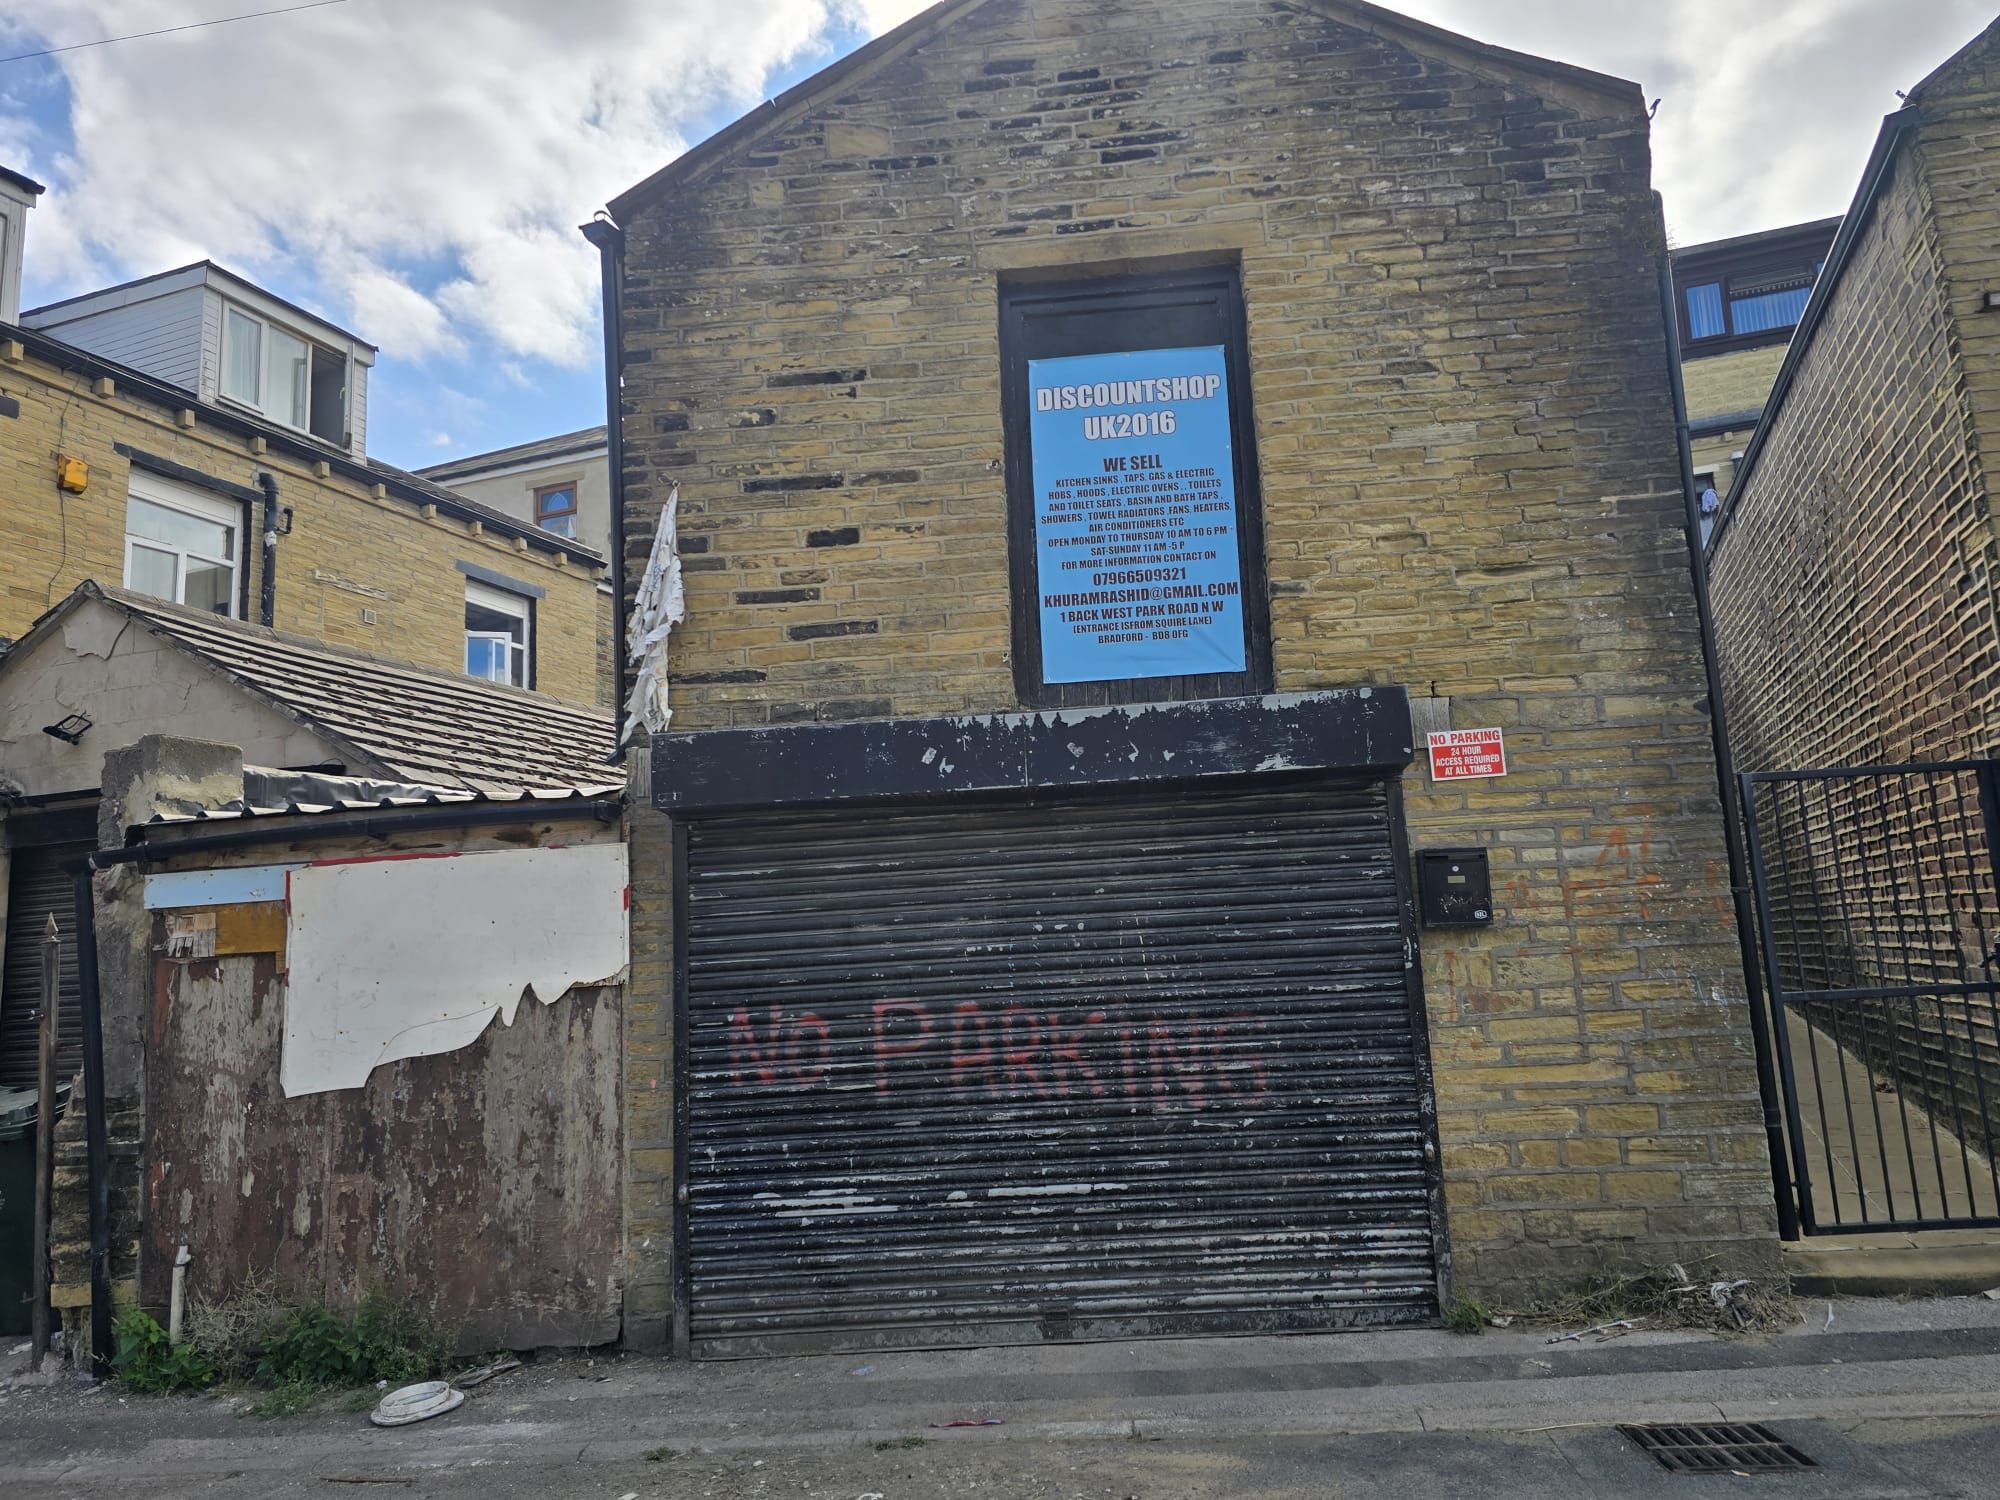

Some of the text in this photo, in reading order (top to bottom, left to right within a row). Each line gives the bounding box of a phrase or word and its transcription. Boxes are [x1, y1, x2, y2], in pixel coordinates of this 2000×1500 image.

[1036, 374, 1221, 411] DISCOUNTSHOP
[1084, 411, 1176, 440] UK2016
[1104, 455, 1162, 472] WE SELL
[1056, 477, 1091, 487] KITCHEN
[1093, 476, 1118, 485] SINKS
[1149, 472, 1165, 480] GAS
[1175, 468, 1214, 478] ELECTRIC
[1049, 479, 1221, 500] HOBS HOODS ELECTRIC OVENS TOILETS
[1049, 492, 1218, 511] AND TOILET SEATS BASIN AND BATH TAPS
[1041, 514, 1083, 524] SHOWERS
[1088, 512, 1116, 521] TOWEL
[1118, 507, 1165, 518] RADIATORS
[1089, 518, 1184, 532] AIR CONDITIONERS ETC
[1048, 526, 1228, 548] OPEN MONDAY TO THURSDAY 10 AM TO 6 PM
[1091, 544, 1141, 556] SAT-SUNDAY
[1145, 543, 1153, 552] 11
[1154, 542, 1167, 551] AM
[1180, 541, 1185, 549] P
[1061, 551, 1216, 570] FOR MORE INFORMATION CONTACT ON
[1093, 567, 1186, 586] 07966509321
[1044, 582, 1238, 608] KHURAMRASHID@GMAIL.COM
[1060, 601, 1224, 622] 1 BACK WEST PARK ROAD N W
[1155, 618, 1187, 628] SQUIRE
[1098, 633, 1143, 644] BRADFORD
[1152, 631, 1170, 640] BD8
[1430, 730, 1500, 745] NO PARKING
[1462, 746, 1481, 755] HOUR
[1436, 755, 1499, 766] ACCESS REQUIRED
[1445, 765, 1492, 776] AT ALL TIMES
